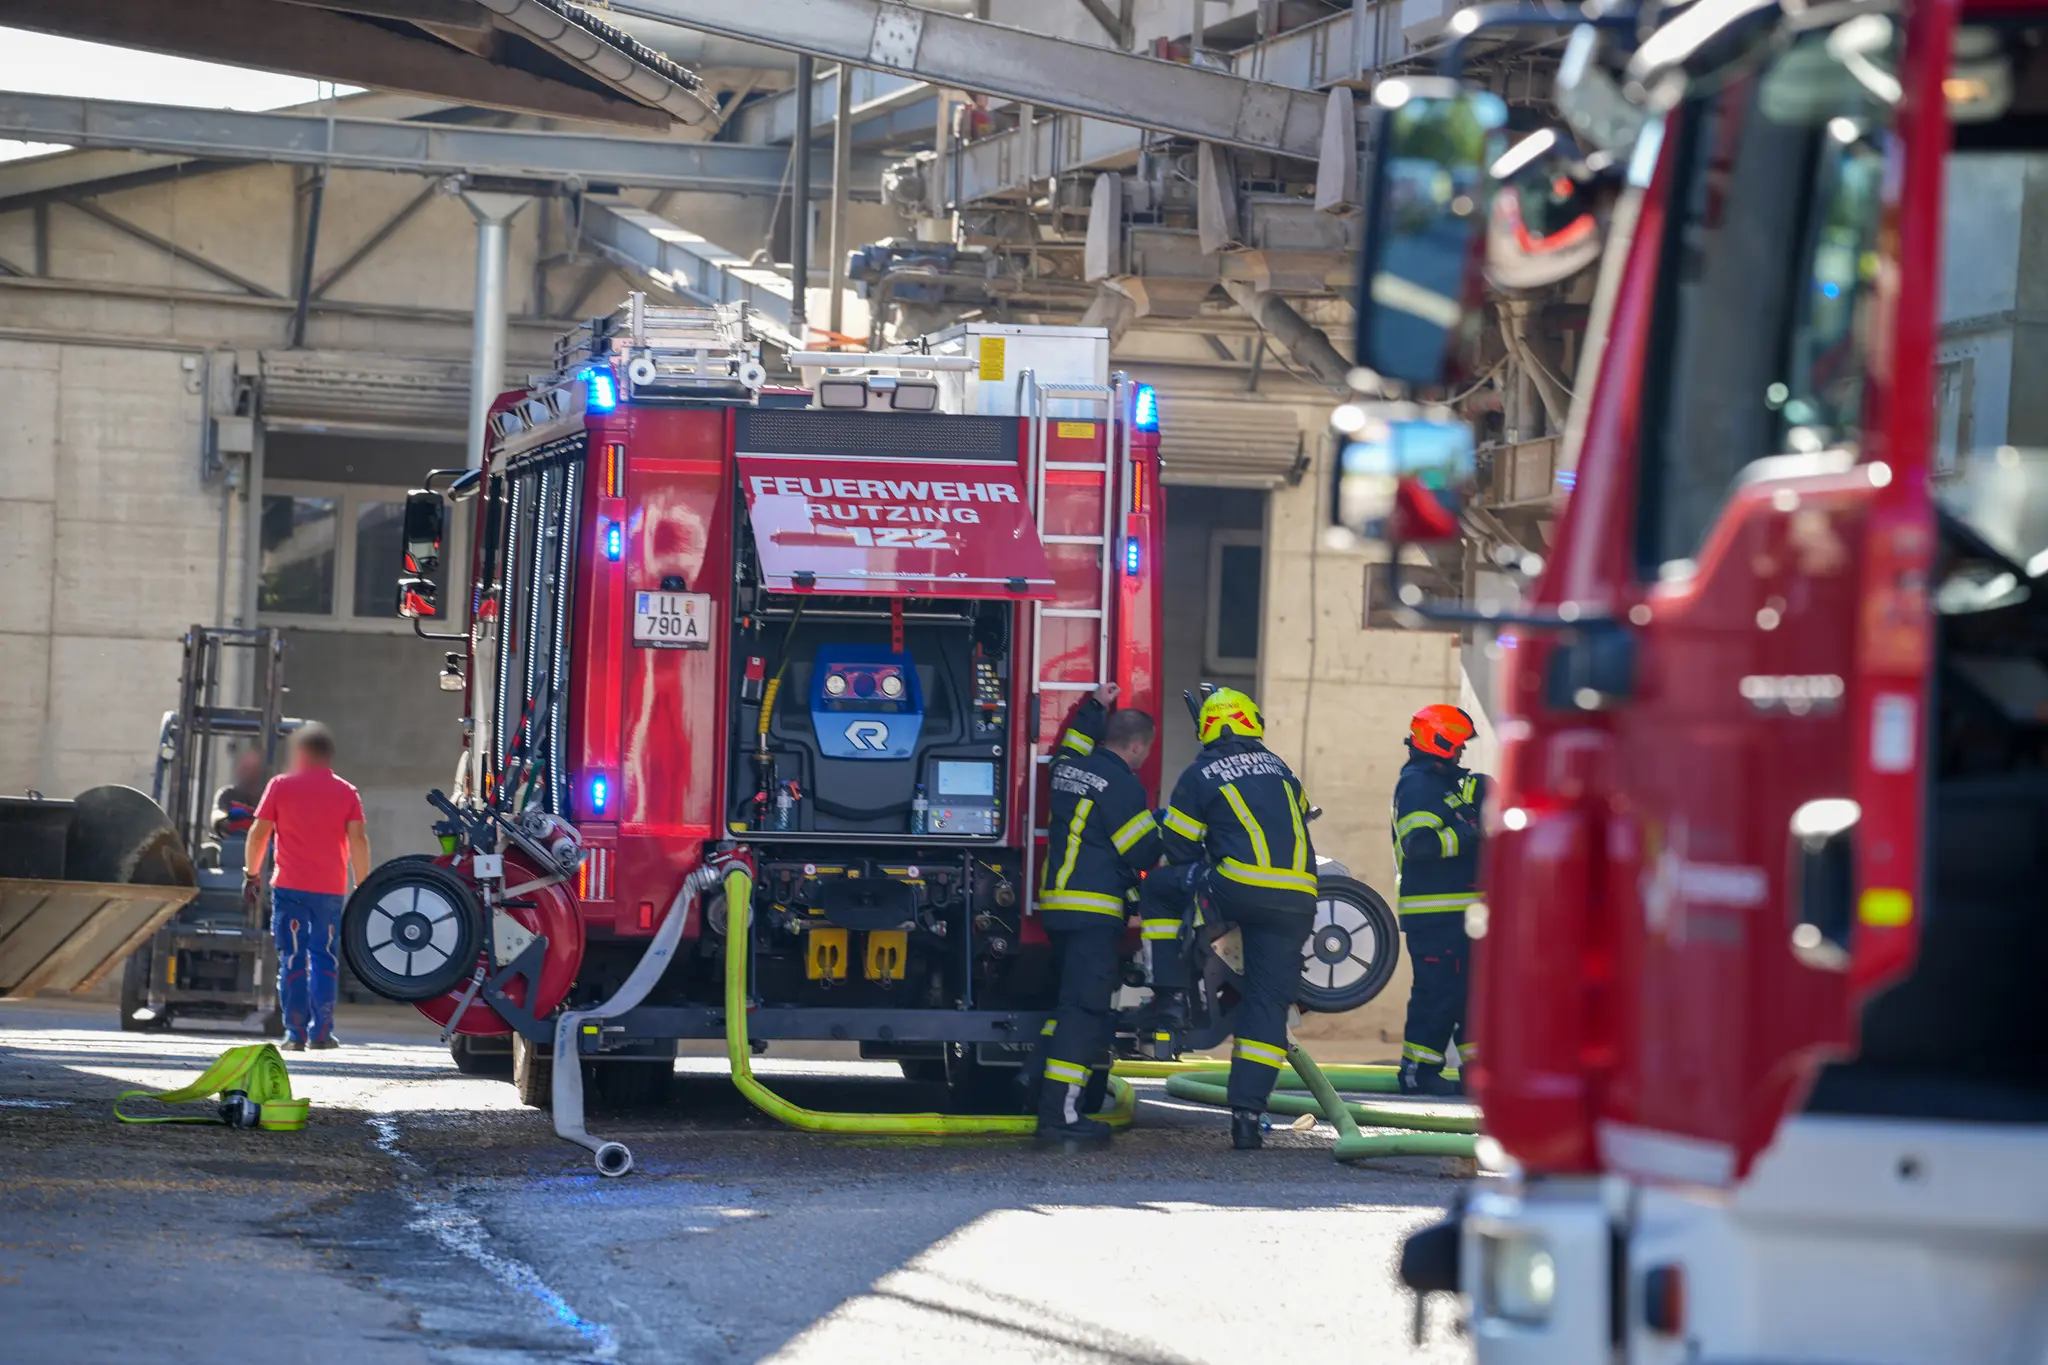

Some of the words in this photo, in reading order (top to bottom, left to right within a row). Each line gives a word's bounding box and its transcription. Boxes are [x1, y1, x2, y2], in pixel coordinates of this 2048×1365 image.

[749, 475, 1020, 504] FEUERWEHR
[804, 502, 981, 524] RUTZING
[846, 526, 951, 549] 122
[660, 596, 680, 615] LL
[647, 616, 682, 636] 790
[684, 617, 698, 637] A
[1220, 763, 1284, 782] RUTZING
